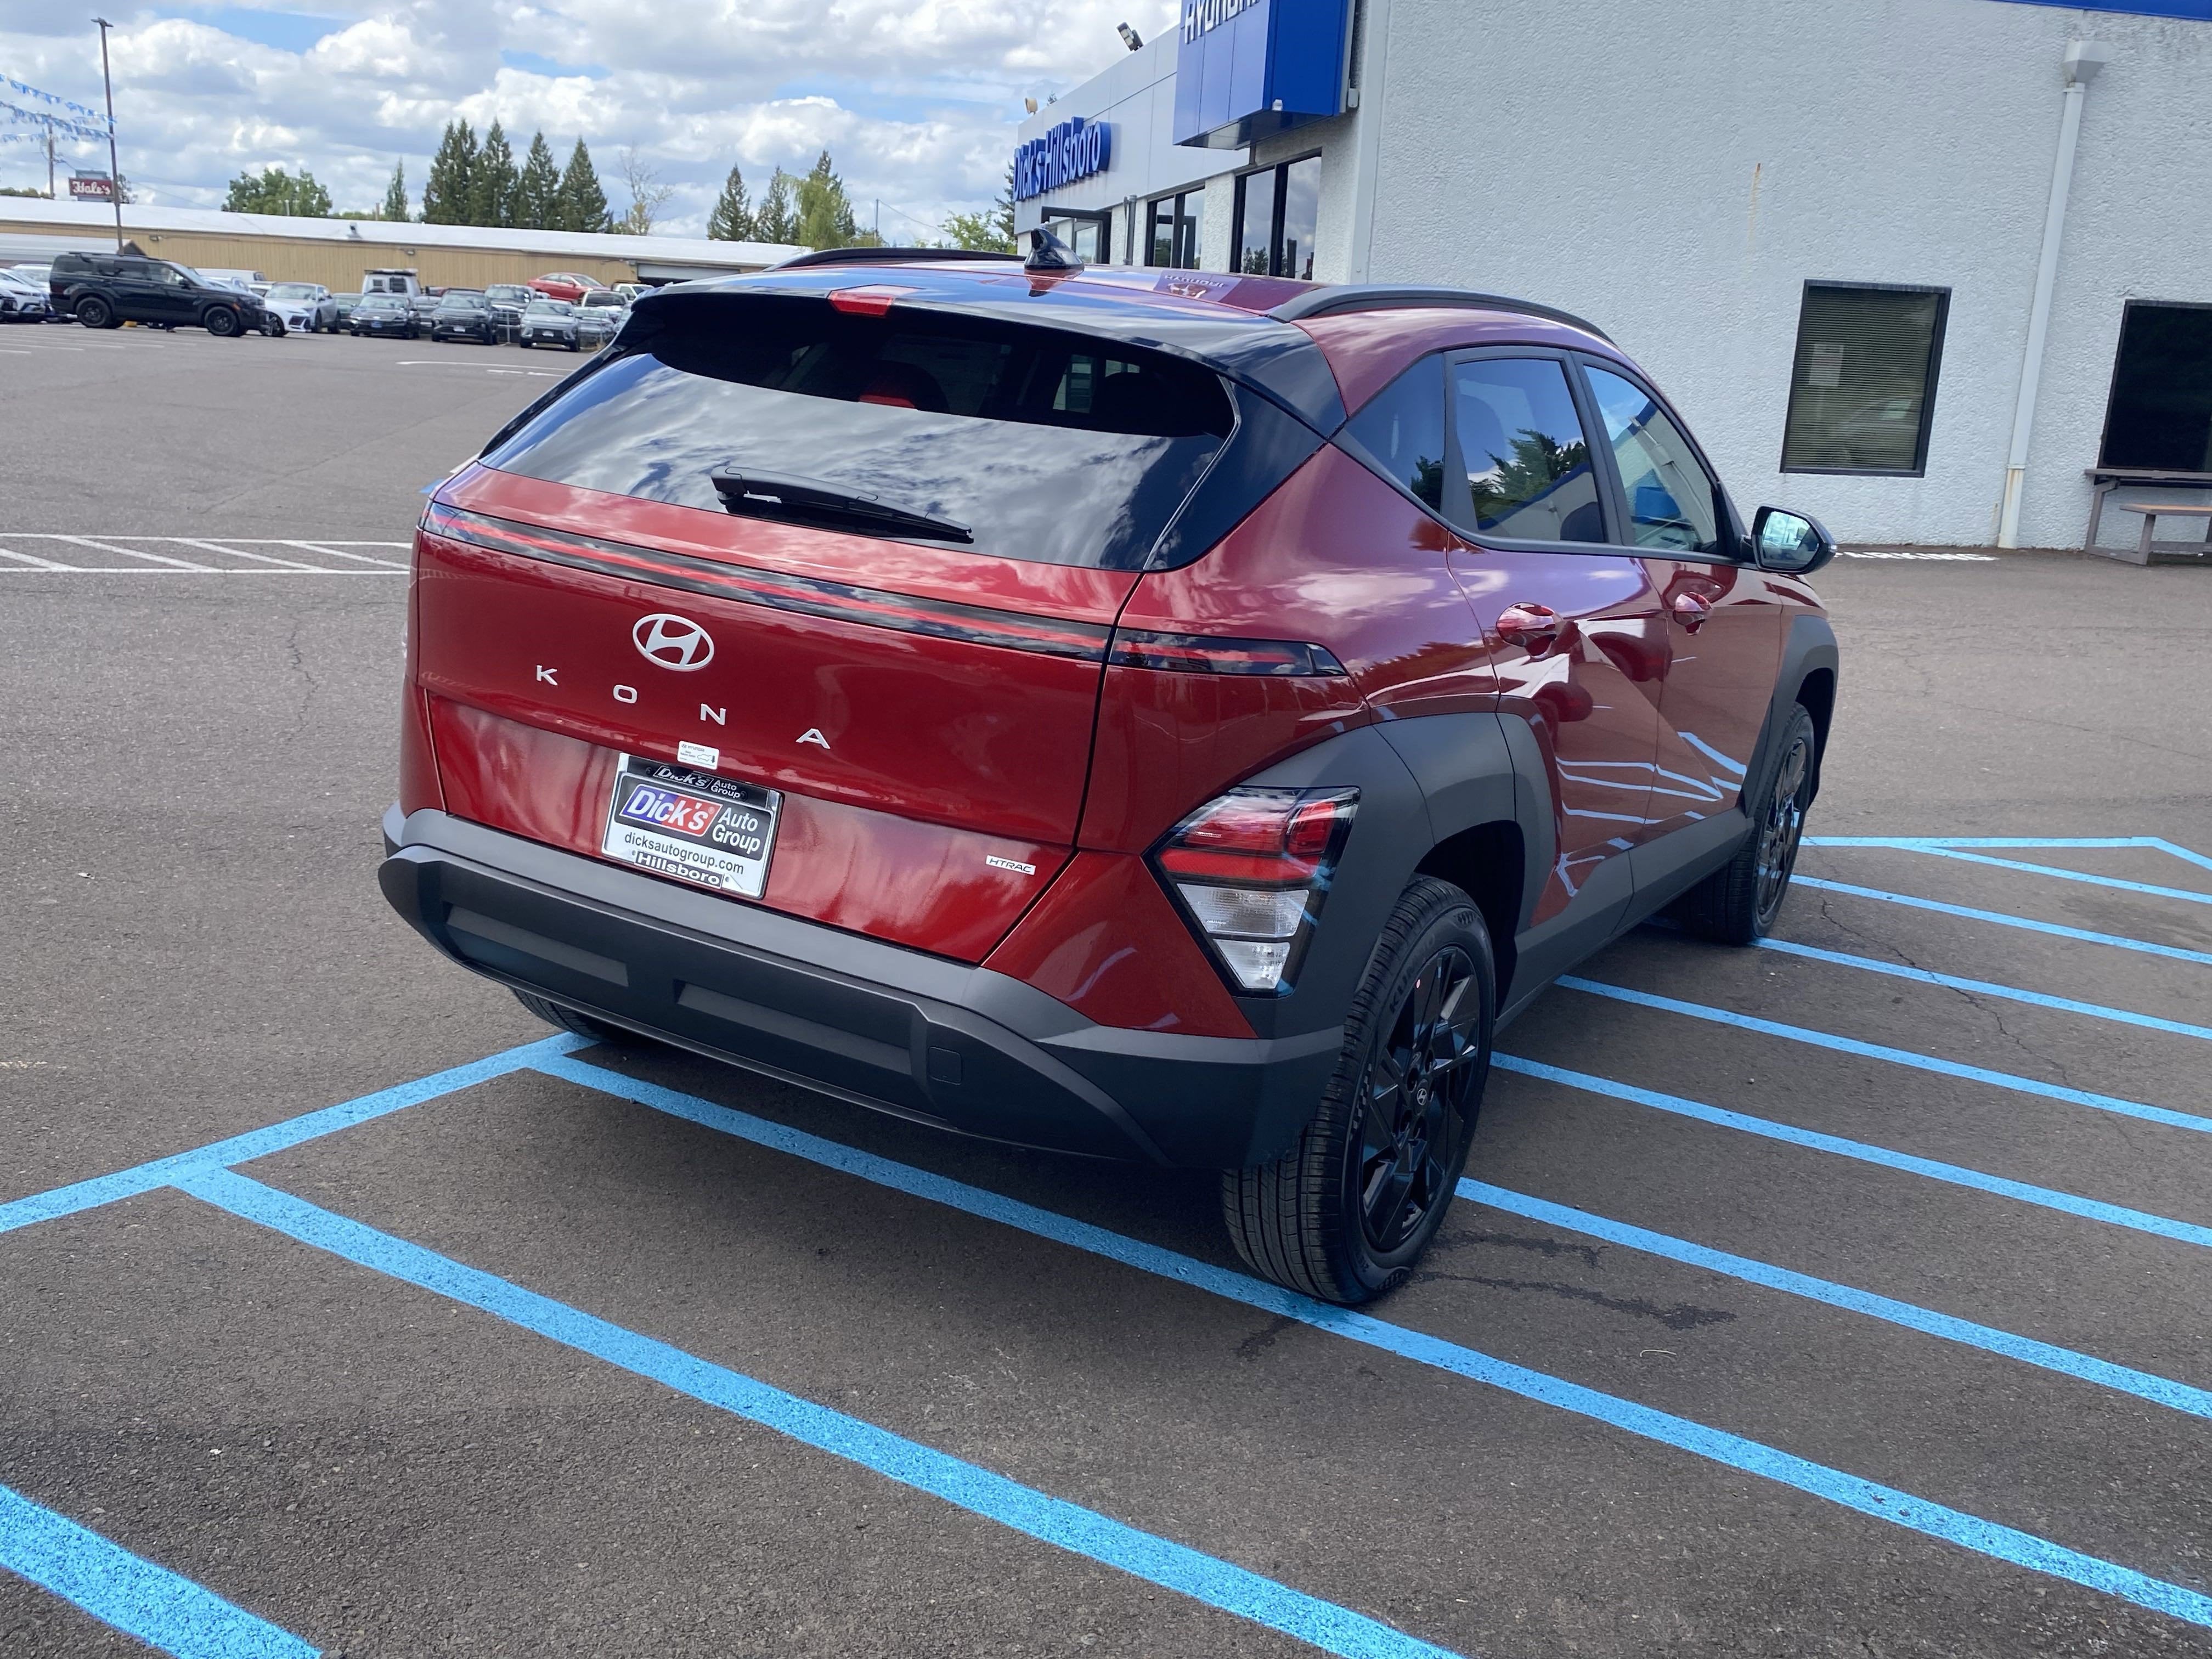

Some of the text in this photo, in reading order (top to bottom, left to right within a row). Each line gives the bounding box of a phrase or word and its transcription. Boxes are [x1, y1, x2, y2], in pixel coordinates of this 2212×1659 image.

[1184, 0, 1261, 44] HYUN
[1013, 116, 1103, 202] Dick's Hillsboro
[72, 180, 111, 195] Hale's
[535, 664, 831, 749] KONA
[710, 786, 741, 799] Group
[713, 780, 737, 791] Auto
[718, 807, 759, 832] Auto
[624, 831, 744, 874] dicksautogroup.com
[712, 823, 761, 855] Group
[636, 851, 720, 885] Hillsboro
[989, 857, 1032, 873] HTRAC
[1389, 933, 1436, 1014] KUMO
